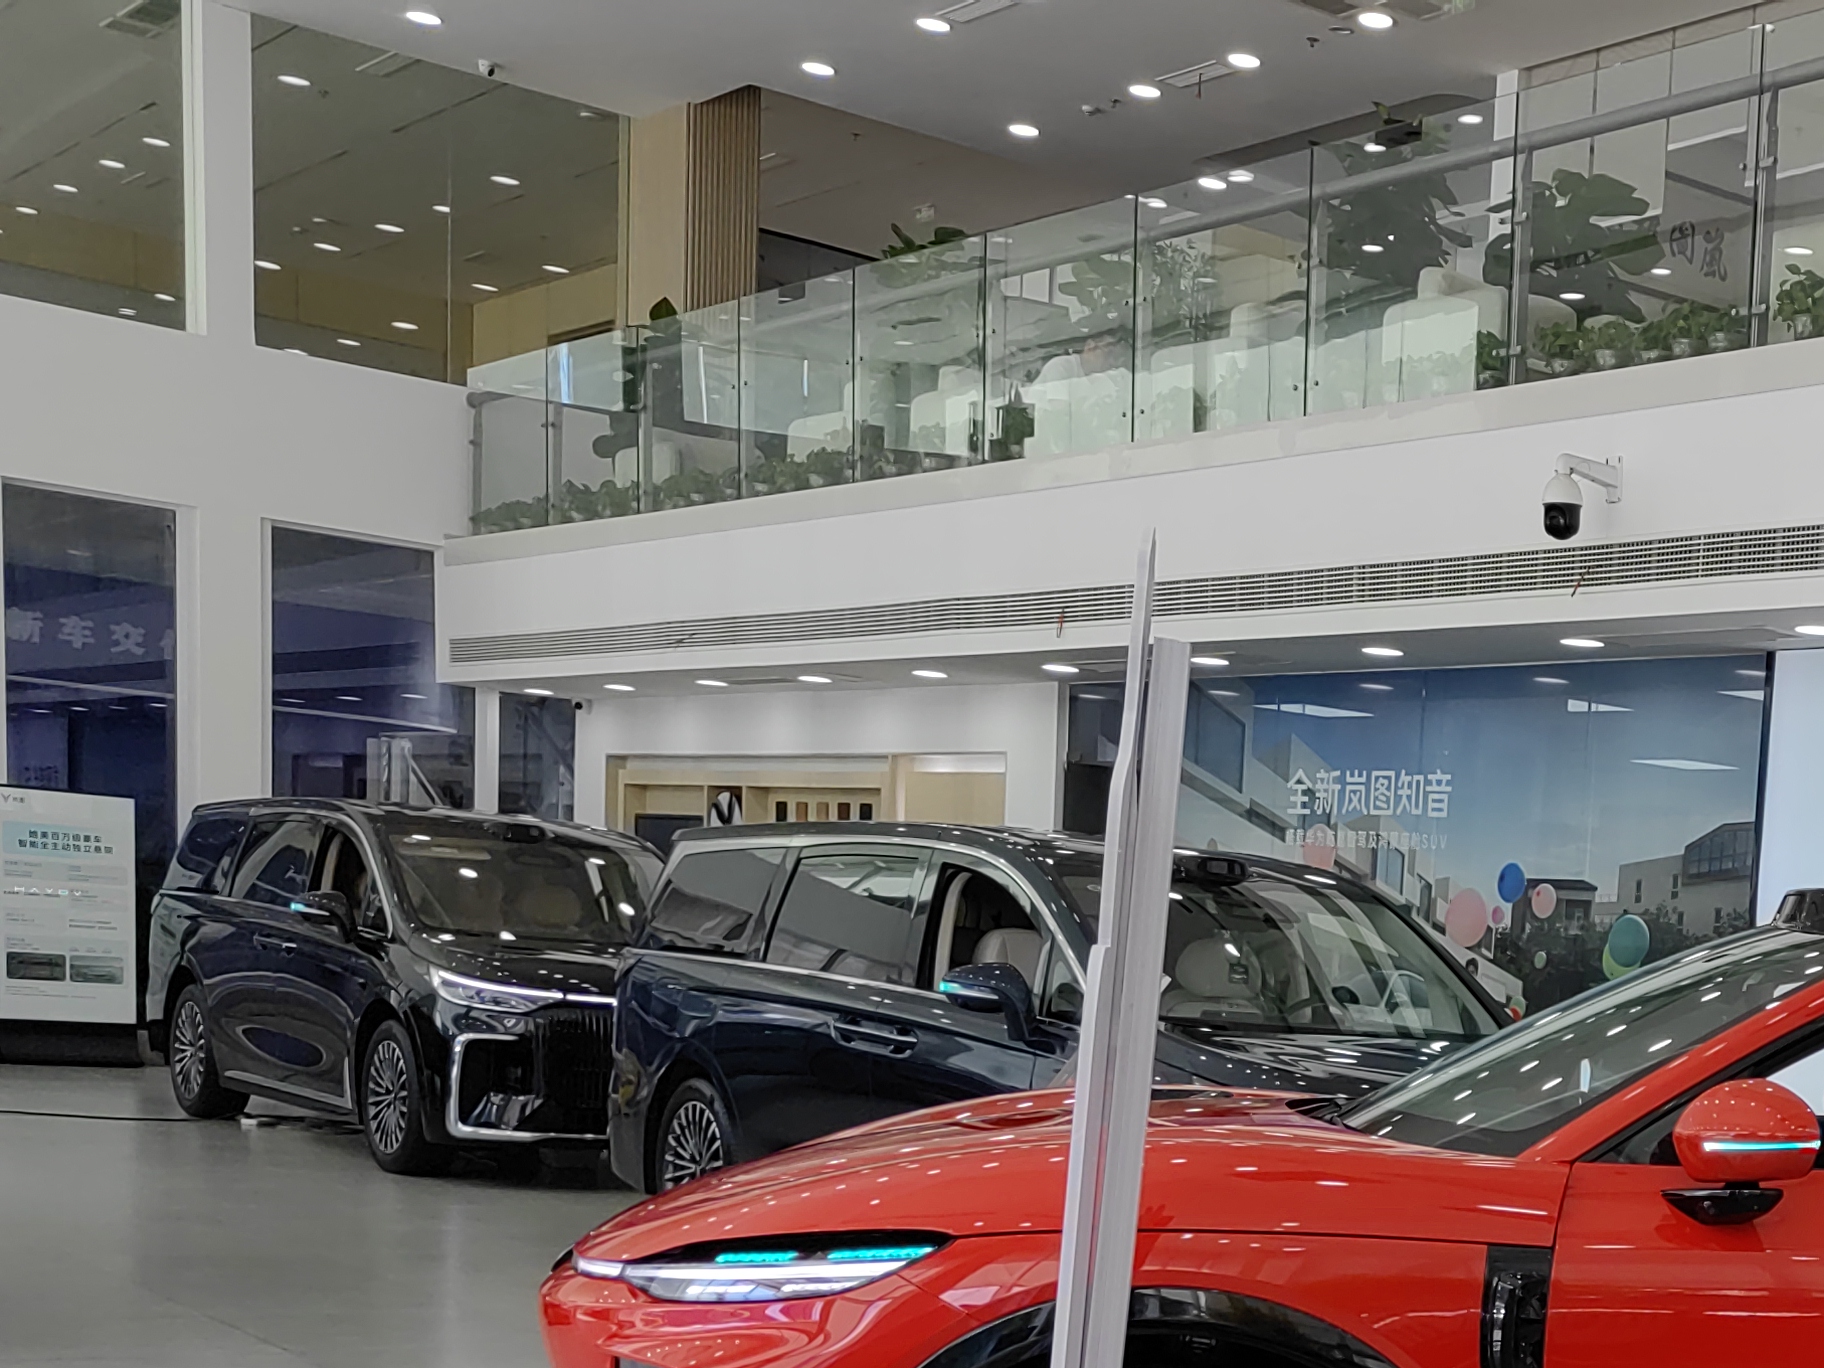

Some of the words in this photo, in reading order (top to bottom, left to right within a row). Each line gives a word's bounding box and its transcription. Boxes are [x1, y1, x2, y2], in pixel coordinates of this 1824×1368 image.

[1286, 768, 1453, 819] 全新岚图知音
